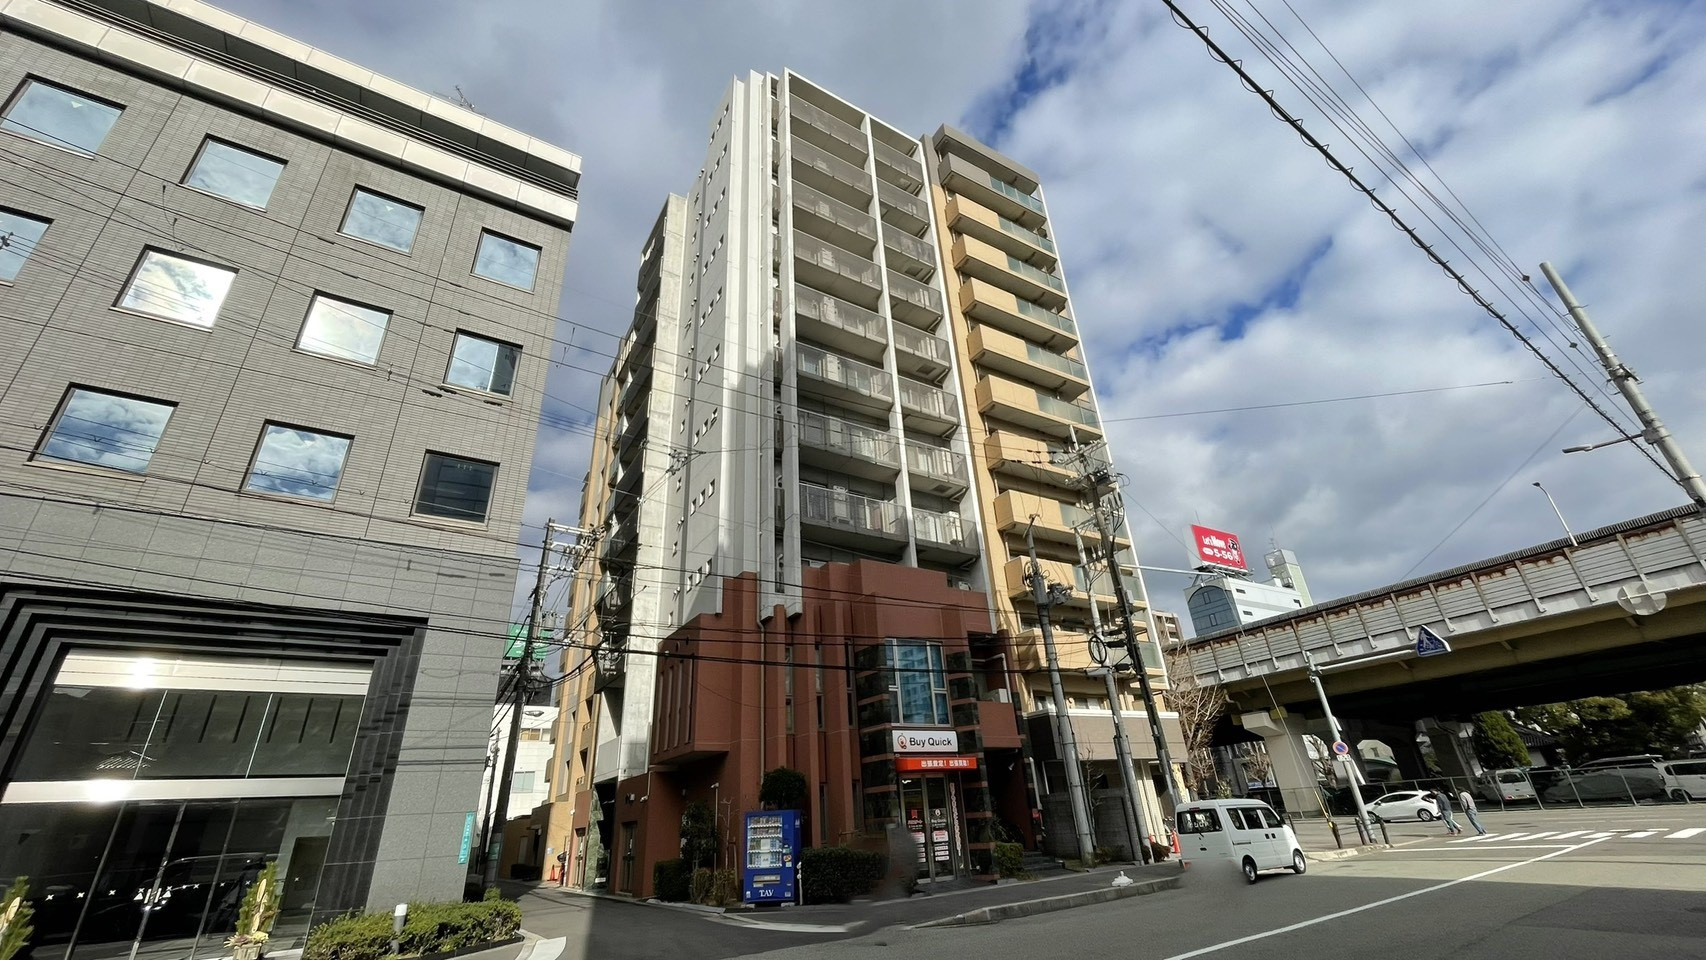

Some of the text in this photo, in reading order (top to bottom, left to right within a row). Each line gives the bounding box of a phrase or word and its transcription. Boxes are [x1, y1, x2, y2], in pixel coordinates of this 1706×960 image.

[1213, 548, 1233, 560] 5-56
[909, 737, 952, 748] Buy Quick
